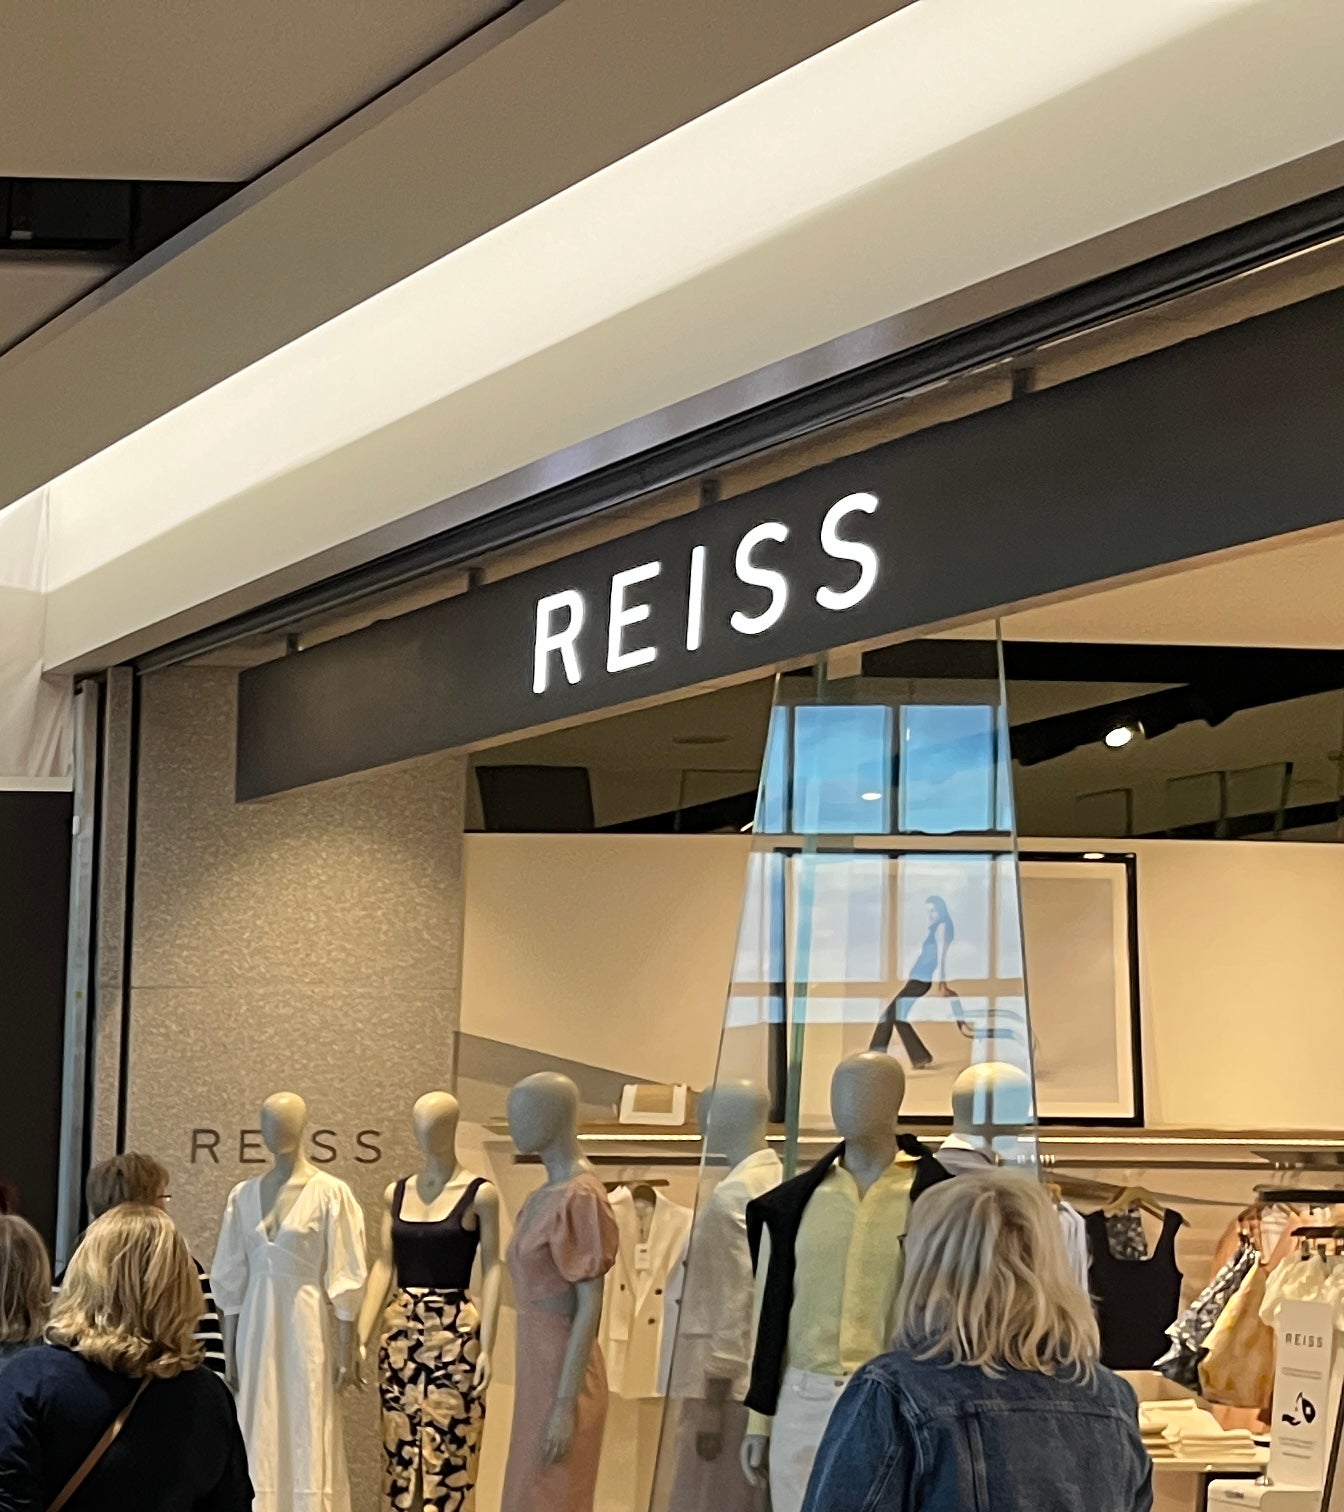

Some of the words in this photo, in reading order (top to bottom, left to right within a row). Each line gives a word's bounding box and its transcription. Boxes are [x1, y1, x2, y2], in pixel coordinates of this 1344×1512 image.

[532, 491, 881, 695] REISS
[189, 1128, 383, 1165] RESS
[1284, 1332, 1324, 1349] REISS
